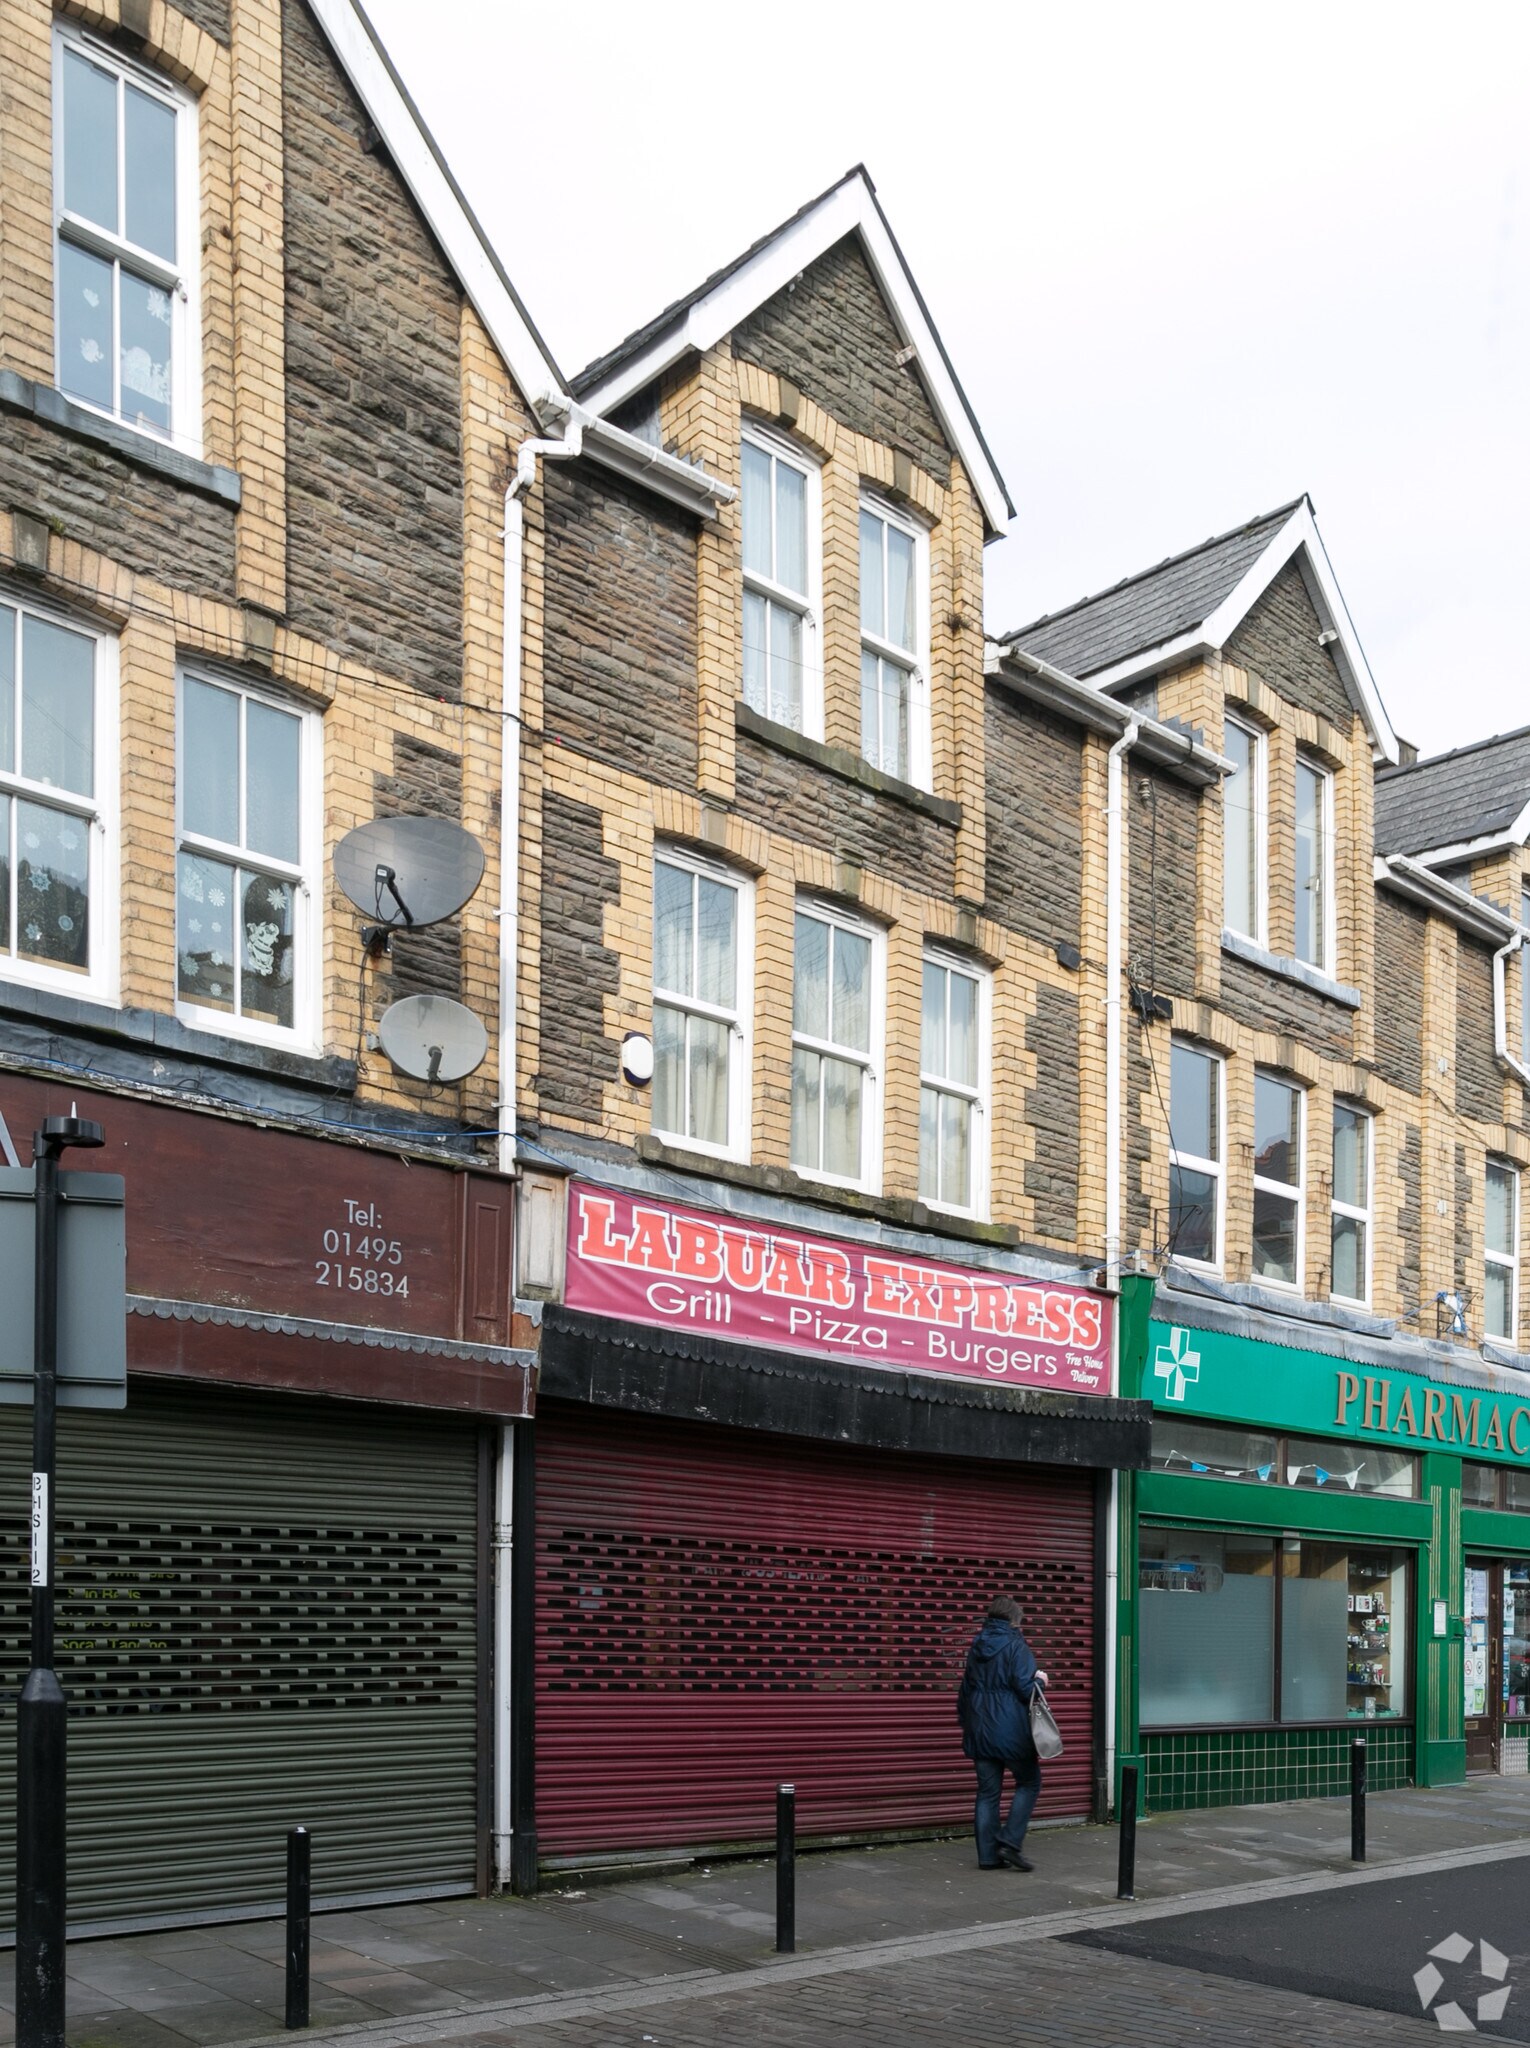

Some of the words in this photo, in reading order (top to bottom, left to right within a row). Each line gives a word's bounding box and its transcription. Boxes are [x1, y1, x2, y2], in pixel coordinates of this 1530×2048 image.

[343, 1198, 382, 1229] Tel:
[323, 1229, 402, 1265] 01495
[315, 1261, 410, 1299] 215834
[578, 1193, 855, 1310] LABUAR
[863, 1255, 1102, 1350] EXPRESS
[646, 1282, 732, 1324] Grill
[789, 1306, 888, 1350] Pizza
[928, 1330, 1058, 1375] Burgers
[1065, 1352, 1082, 1367] Free
[1083, 1355, 1104, 1370] Home
[1070, 1369, 1099, 1388] Delivery
[1334, 1371, 1530, 1455] PHARMAC
